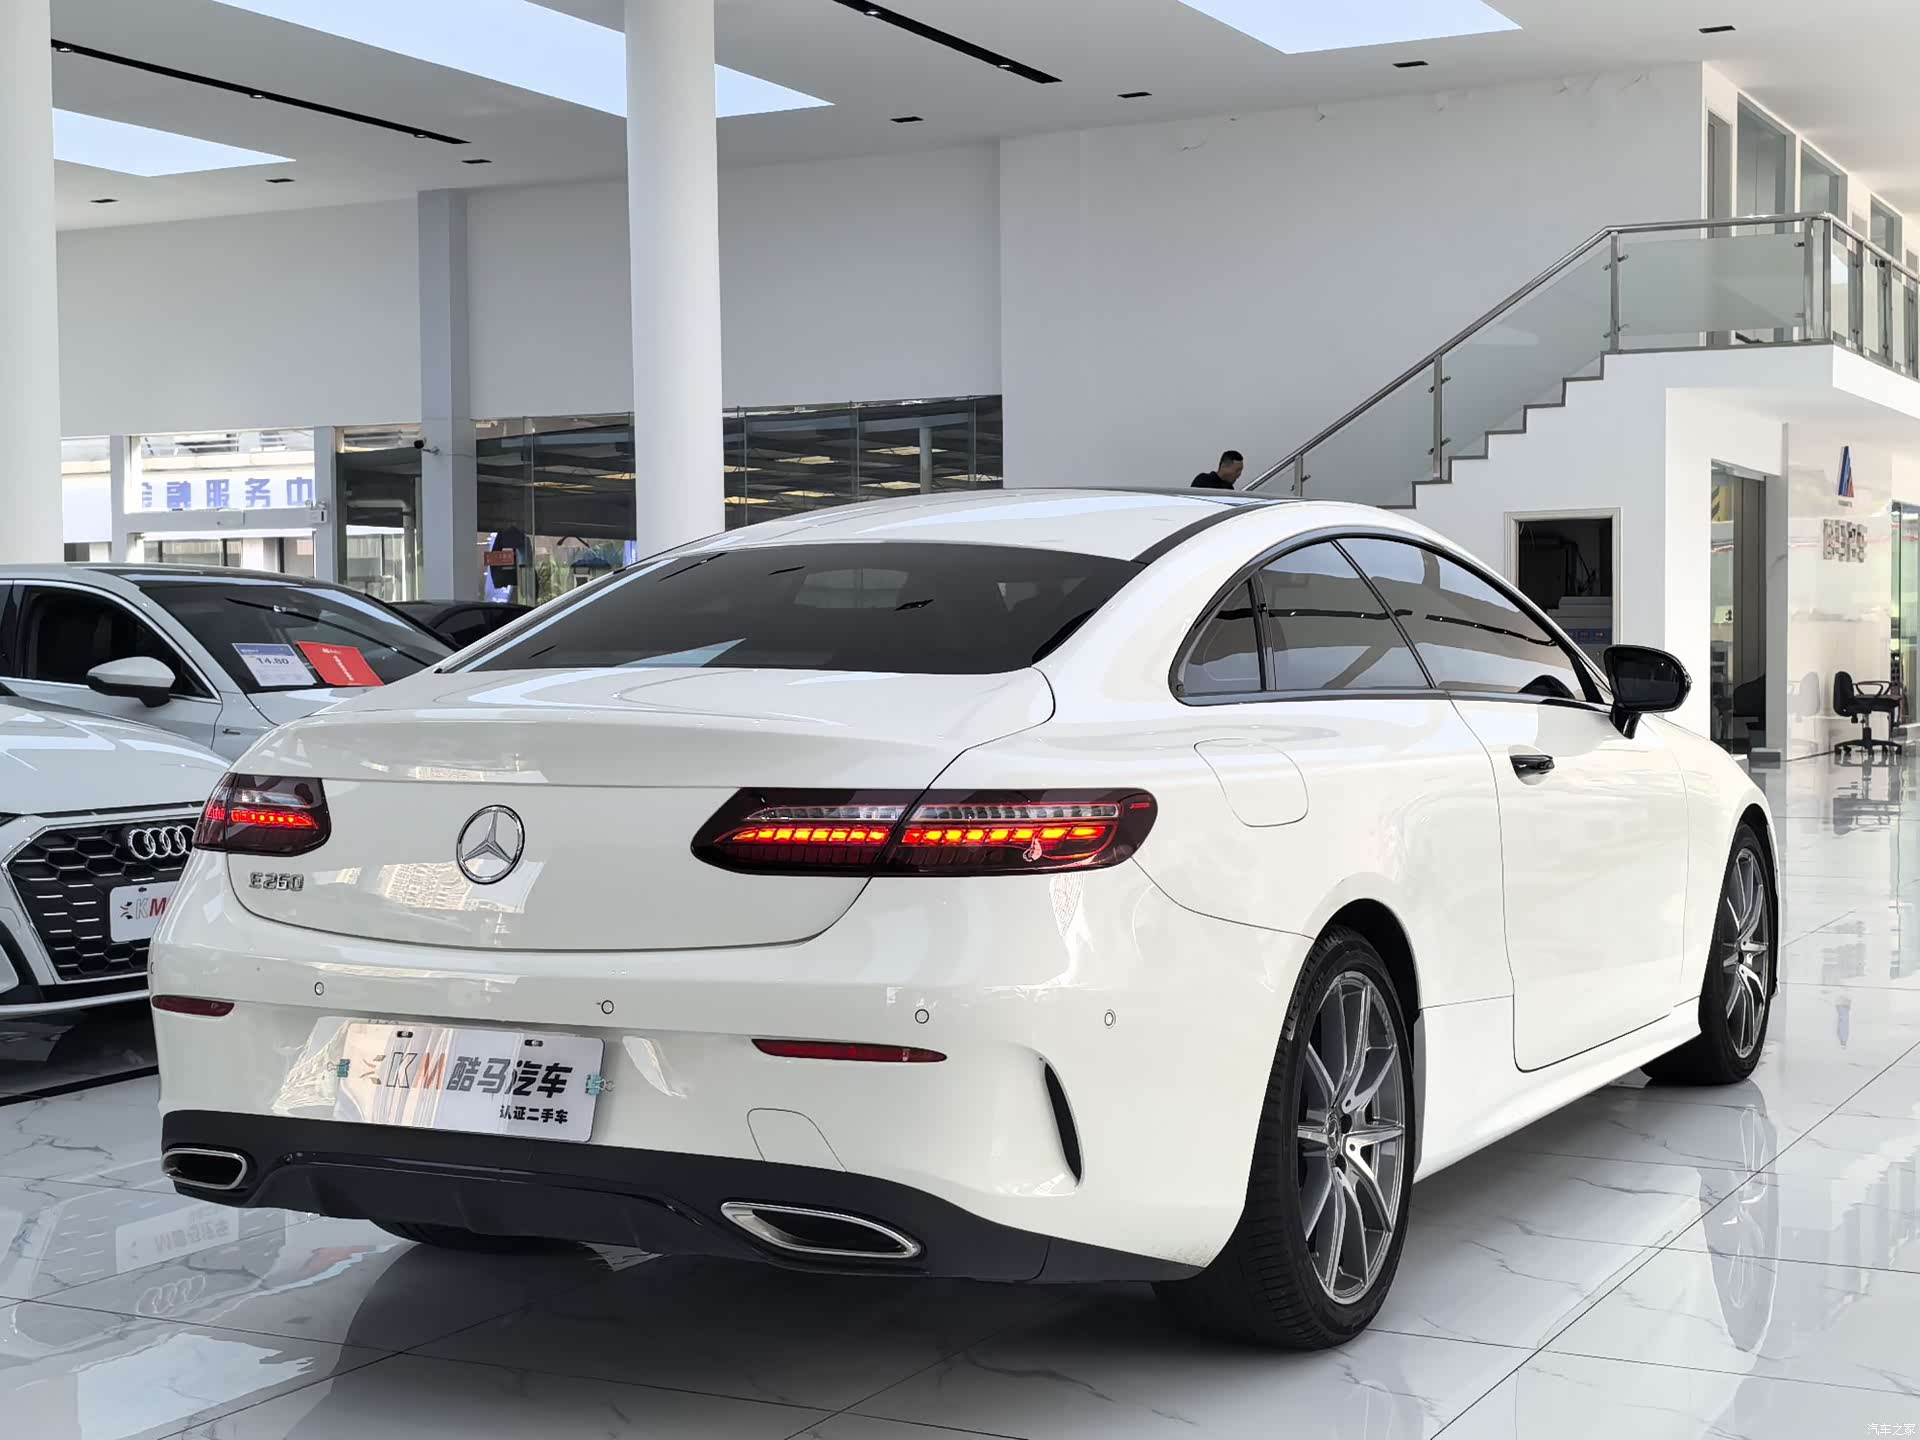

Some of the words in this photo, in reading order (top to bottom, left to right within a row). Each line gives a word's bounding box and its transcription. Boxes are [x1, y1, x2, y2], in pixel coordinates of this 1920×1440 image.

[249, 871, 304, 892] E260
[499, 1104, 568, 1124] 认证二手车
